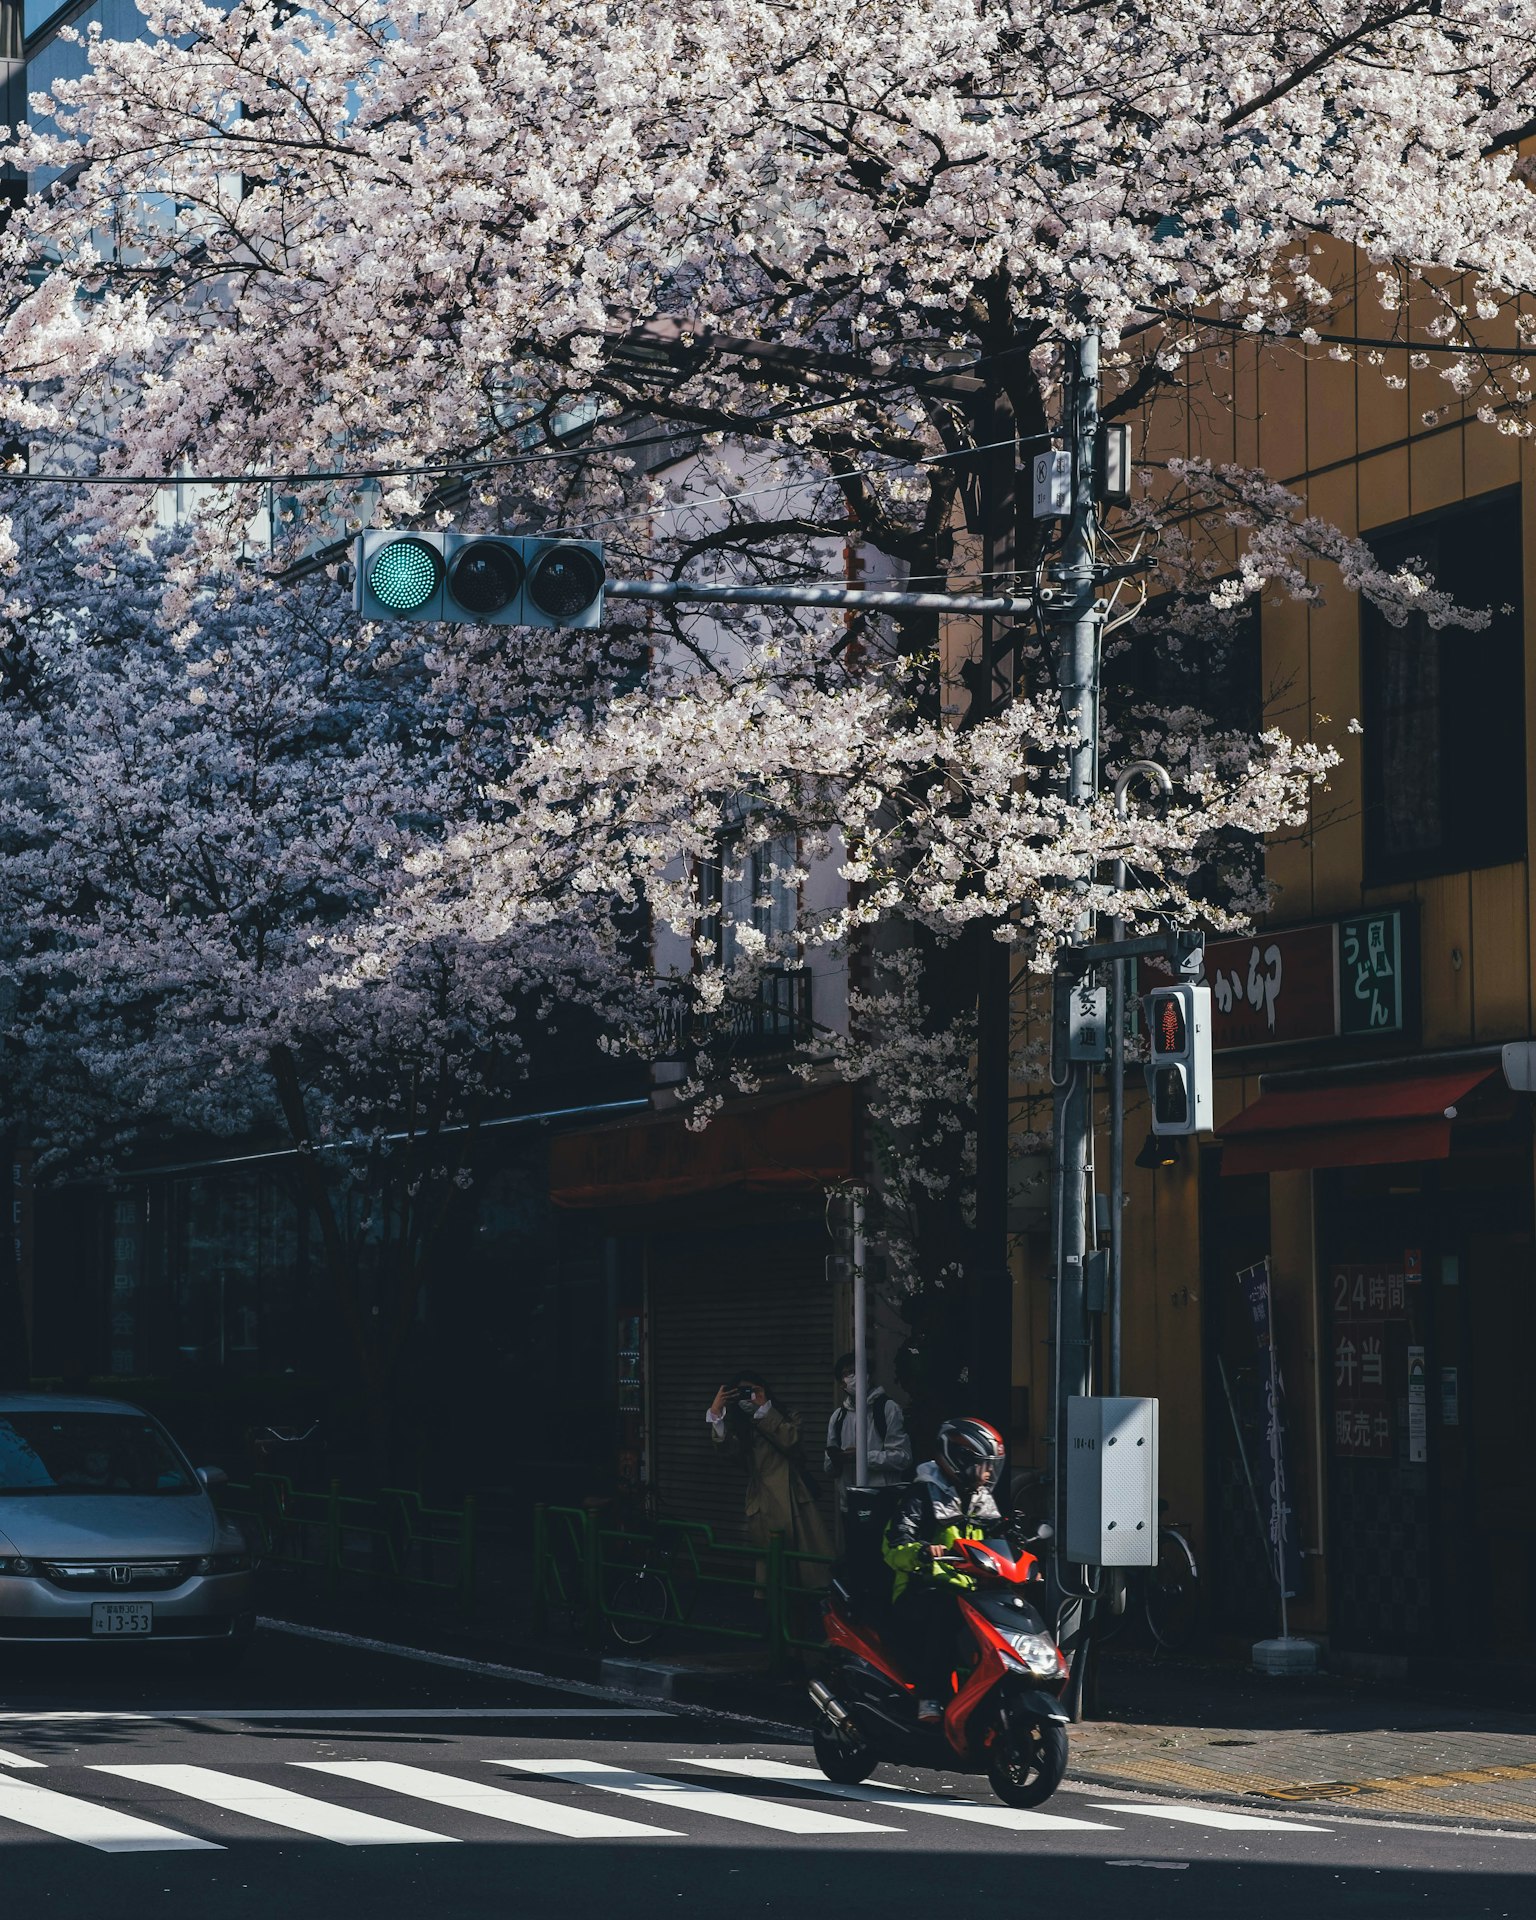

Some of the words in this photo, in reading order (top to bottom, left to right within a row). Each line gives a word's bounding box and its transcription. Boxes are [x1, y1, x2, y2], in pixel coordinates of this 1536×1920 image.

[1343, 927, 1389, 1026] うどん
[1333, 1273, 1406, 1312] 24時間
[1334, 1336, 1384, 1387] 弁当
[1335, 1409, 1390, 1448] 販売中
[107, 1615, 149, 1631] 13-53
